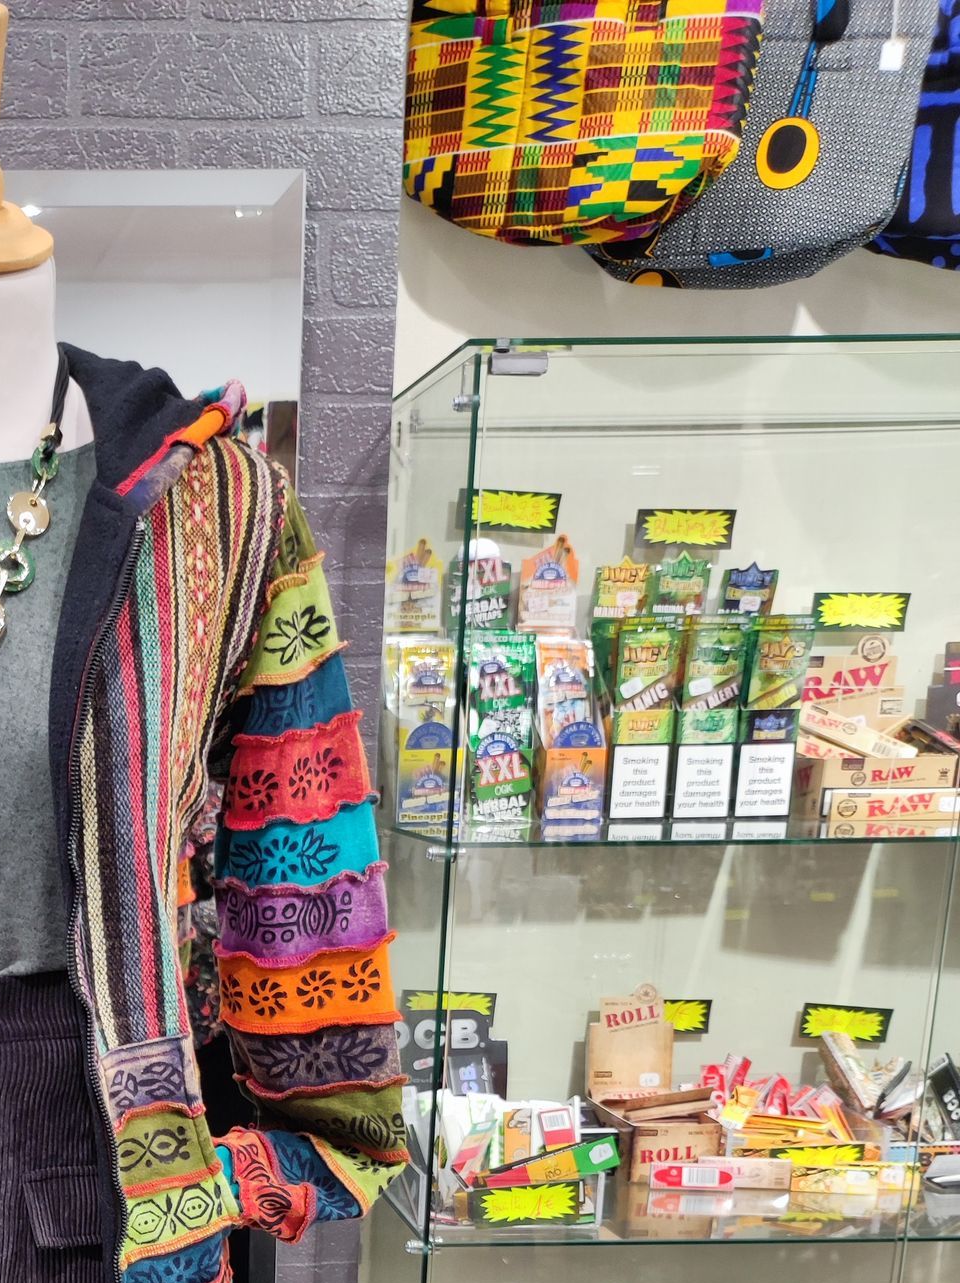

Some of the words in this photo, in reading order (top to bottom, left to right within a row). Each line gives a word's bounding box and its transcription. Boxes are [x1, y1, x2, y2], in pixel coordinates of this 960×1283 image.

[469, 558, 508, 586] XL
[601, 564, 648, 583] JUICY
[623, 644, 670, 663] JUICY
[801, 662, 889, 702] RAW
[622, 757, 659, 766] Smoking
[687, 757, 724, 766] Smoking
[748, 756, 785, 765] Smoking
[477, 751, 528, 787] XXL
[697, 768, 712, 776] this
[758, 766, 774, 774] this
[871, 766, 916, 782] RAW
[623, 779, 656, 788] product
[686, 779, 720, 788] product
[748, 777, 781, 786] product
[619, 790, 657, 798] damages
[683, 790, 721, 799] damages
[744, 788, 783, 797] damages
[472, 794, 528, 816] HERBAL
[614, 801, 632, 809] your
[634, 800, 660, 808] health
[677, 801, 696, 809] your
[698, 800, 724, 808] health
[740, 800, 758, 808] your
[760, 798, 786, 806] health
[866, 792, 936, 819] RAW
[604, 1004, 661, 1030] ROLL
[640, 1144, 698, 1165] ROLL
